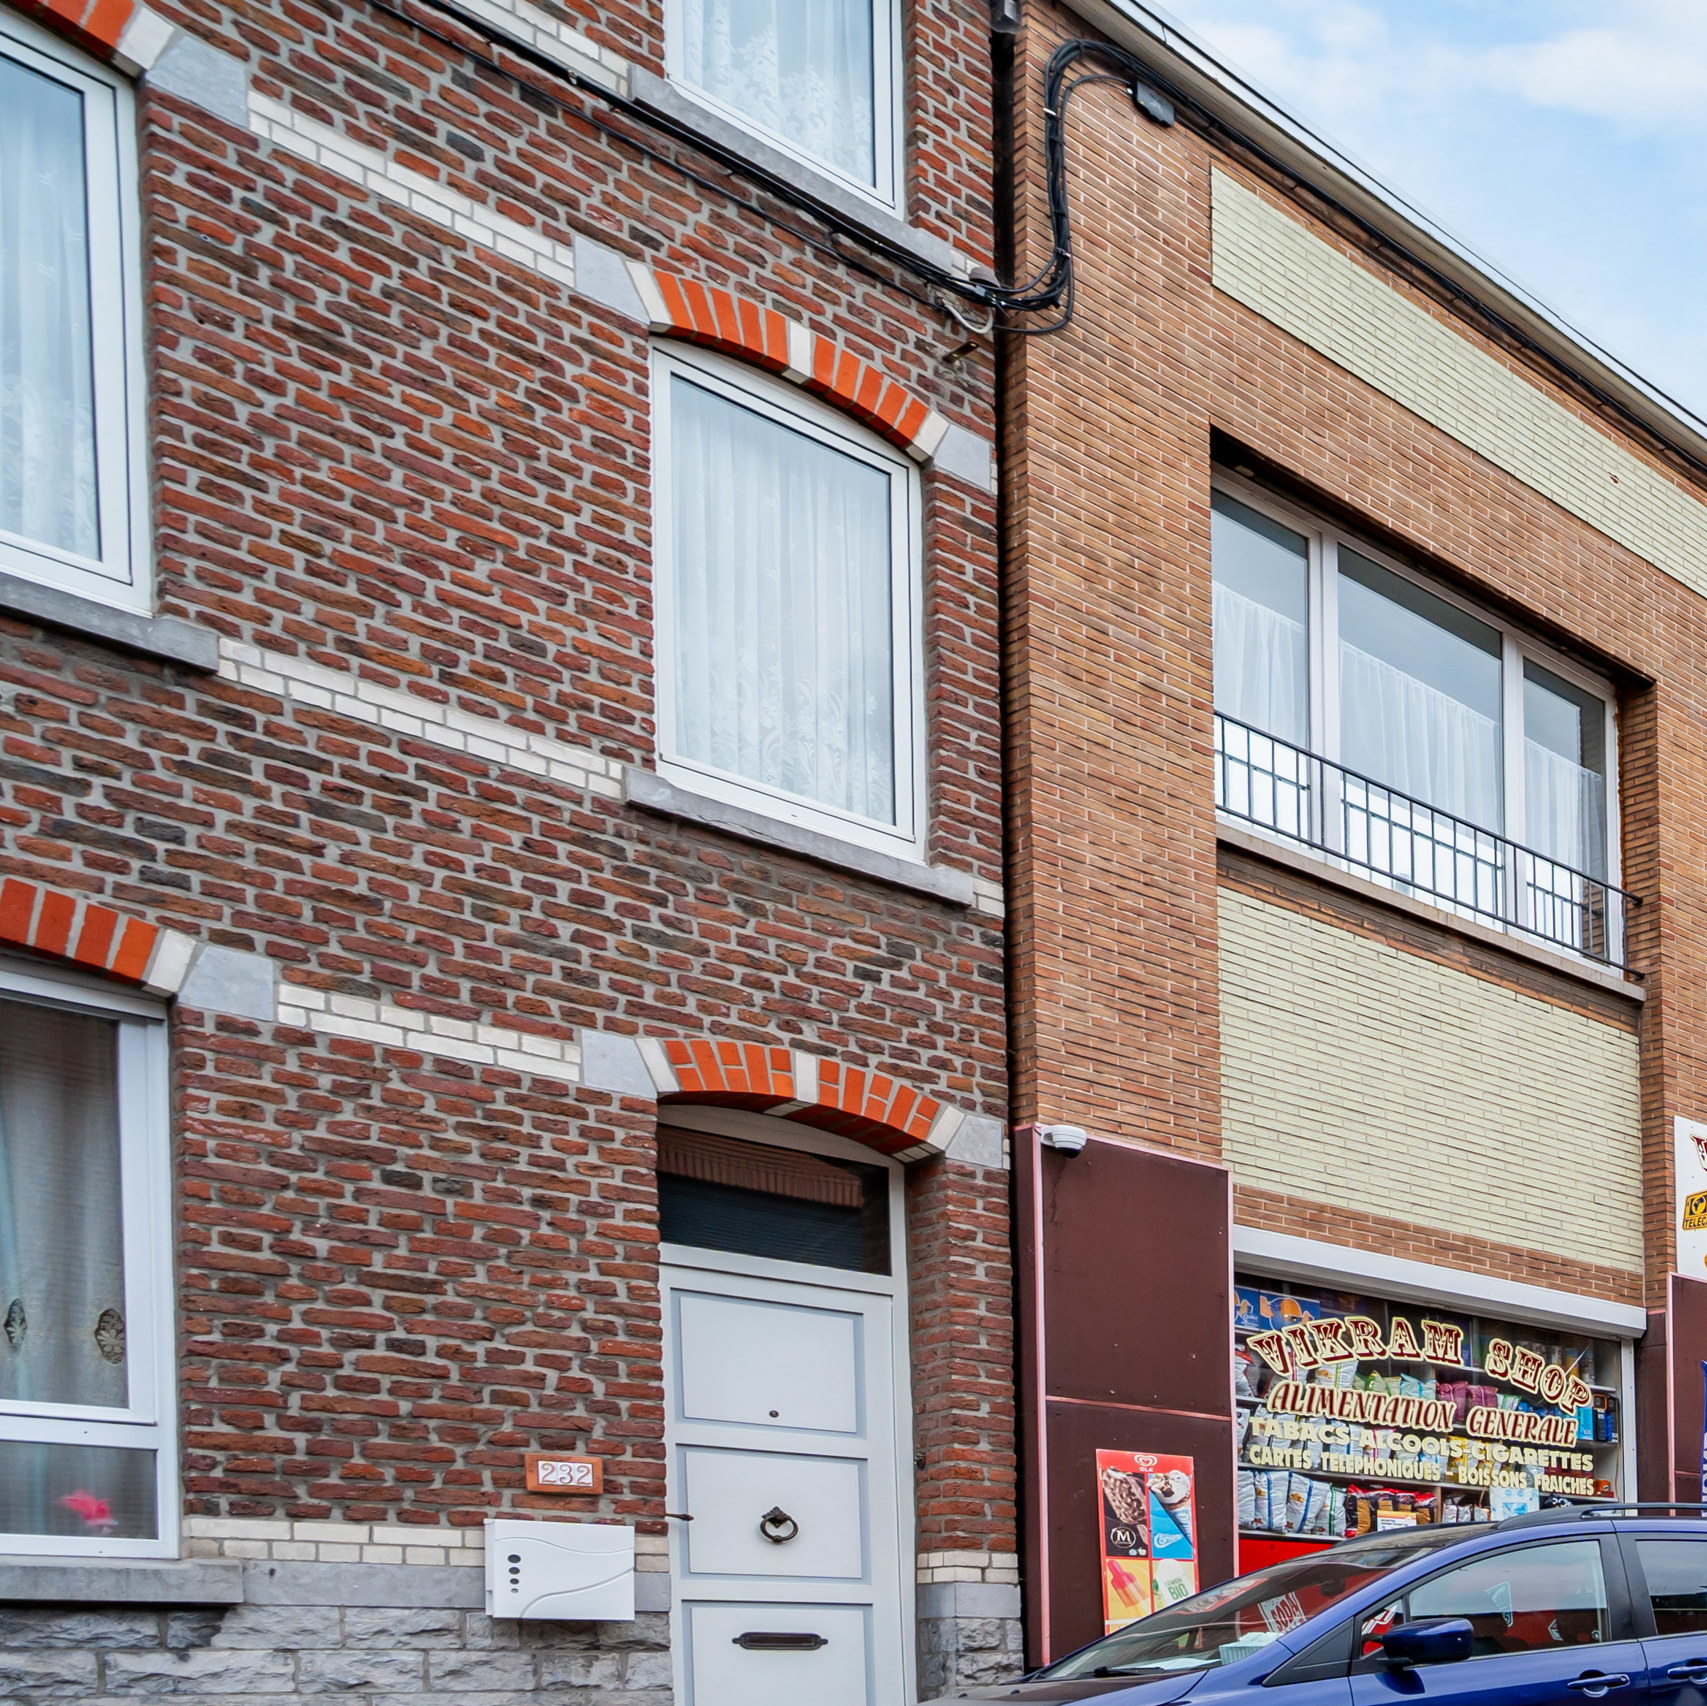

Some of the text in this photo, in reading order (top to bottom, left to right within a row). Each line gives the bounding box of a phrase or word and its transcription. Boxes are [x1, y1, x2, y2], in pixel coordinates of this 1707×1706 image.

[1247, 1316, 1592, 1416] VIKRAM SHOP
[1267, 1381, 1579, 1447] ALIMENTATION GENERALE
[1249, 1416, 1594, 1472] TABACS-ALCOOLS-CIGARETTES
[540, 1462, 592, 1487] 232
[1249, 1444, 1312, 1470] CARTES
[1320, 1451, 1441, 1482] TELEPHONIQUES
[1458, 1465, 1528, 1489] BOISSONS
[1534, 1473, 1594, 1496] FRAICHES
[1164, 1578, 1182, 1587] LEMON
[1168, 1583, 1189, 1600] BIO
[1270, 1593, 1299, 1632] SODA
